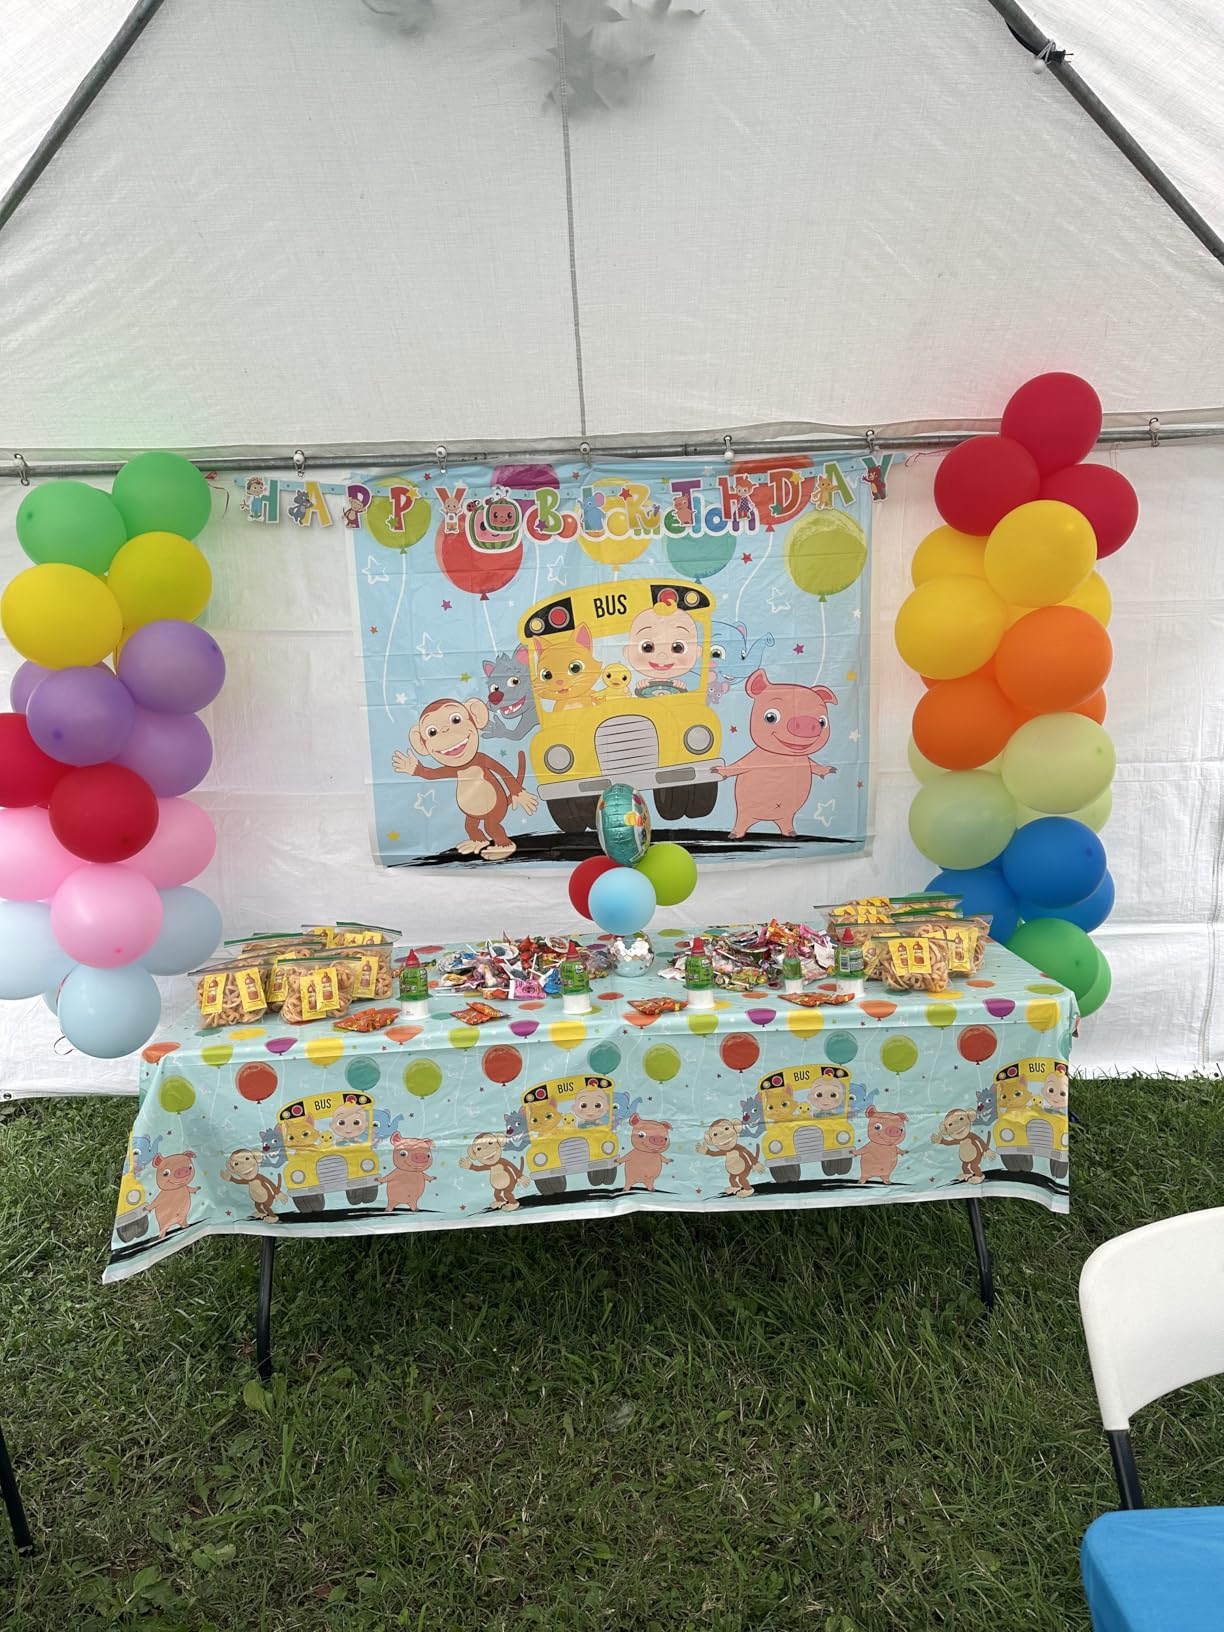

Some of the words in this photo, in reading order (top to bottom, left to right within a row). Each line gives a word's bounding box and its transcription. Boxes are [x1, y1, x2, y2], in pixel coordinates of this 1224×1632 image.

[246, 479, 468, 533] HAPPY
[593, 593, 628, 619] BUS
[1028, 1062, 1046, 1074] BUS
[793, 1070, 810, 1082] BUS
[556, 1081, 574, 1094] BUS
[313, 1098, 332, 1111] BUS
